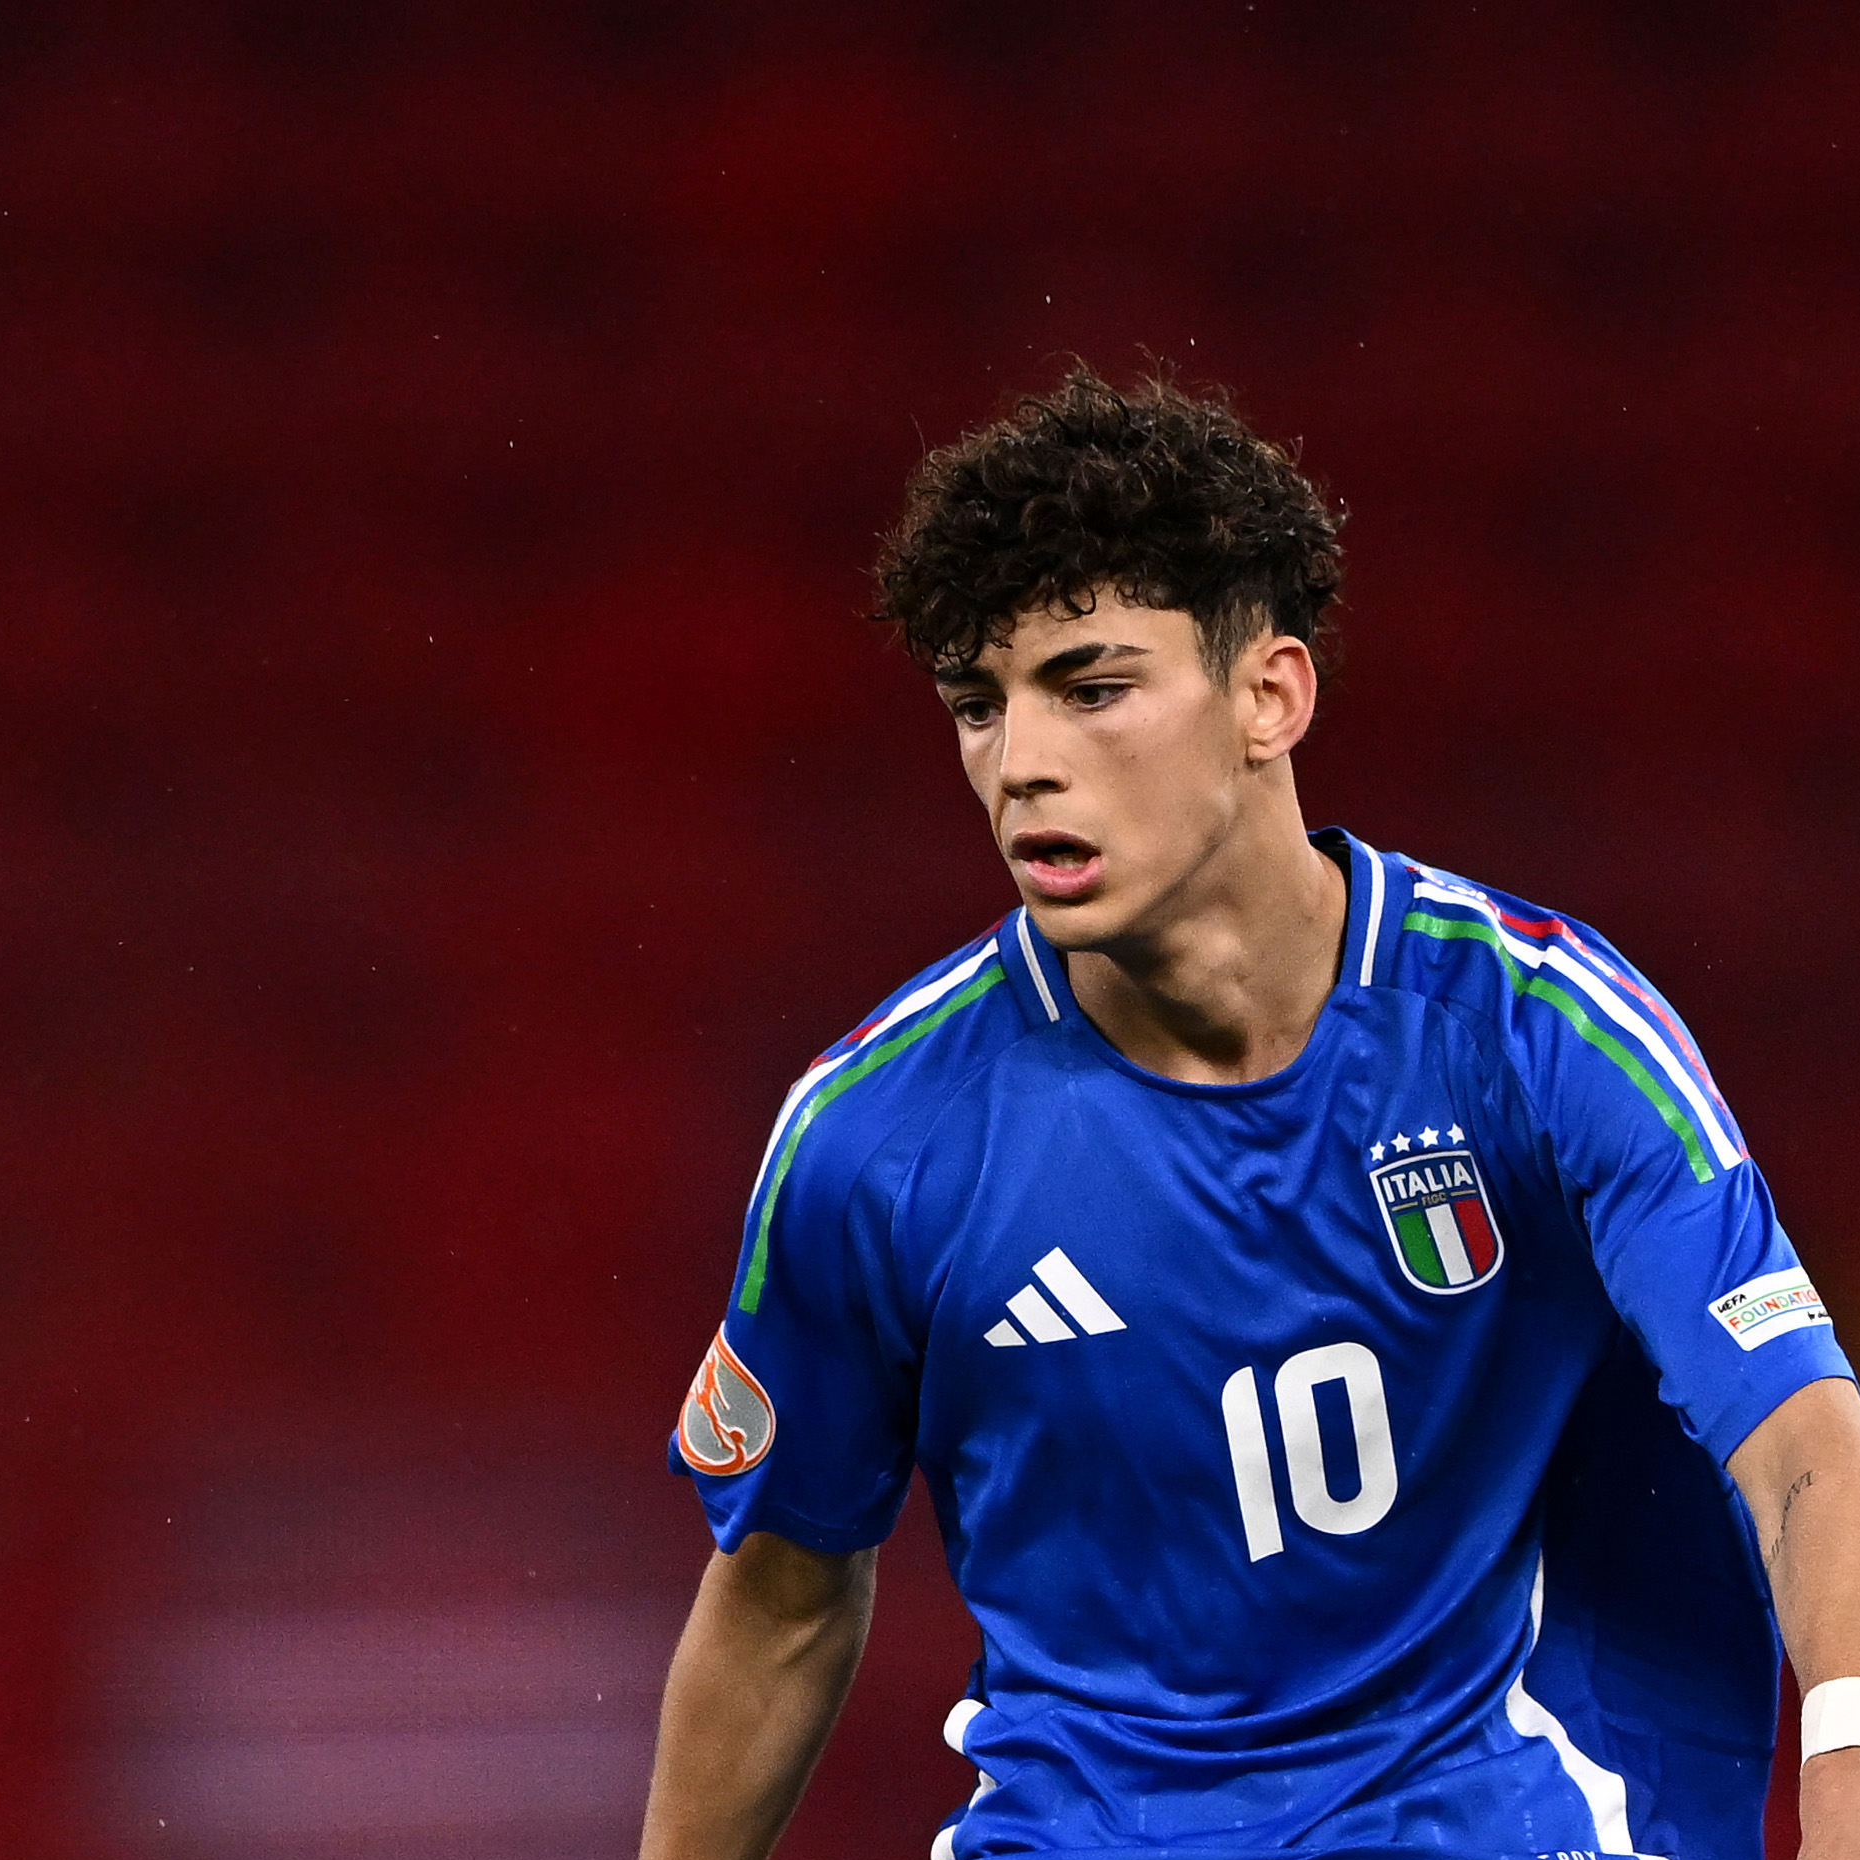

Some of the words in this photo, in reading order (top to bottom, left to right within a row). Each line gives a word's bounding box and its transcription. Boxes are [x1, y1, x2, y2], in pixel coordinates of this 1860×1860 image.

[1381, 1161, 1474, 1203] ITALIA
[1717, 1293, 1747, 1313] UEFA
[1728, 1289, 1819, 1330] FOUNDATIO
[1221, 1341, 1398, 1563] 10
